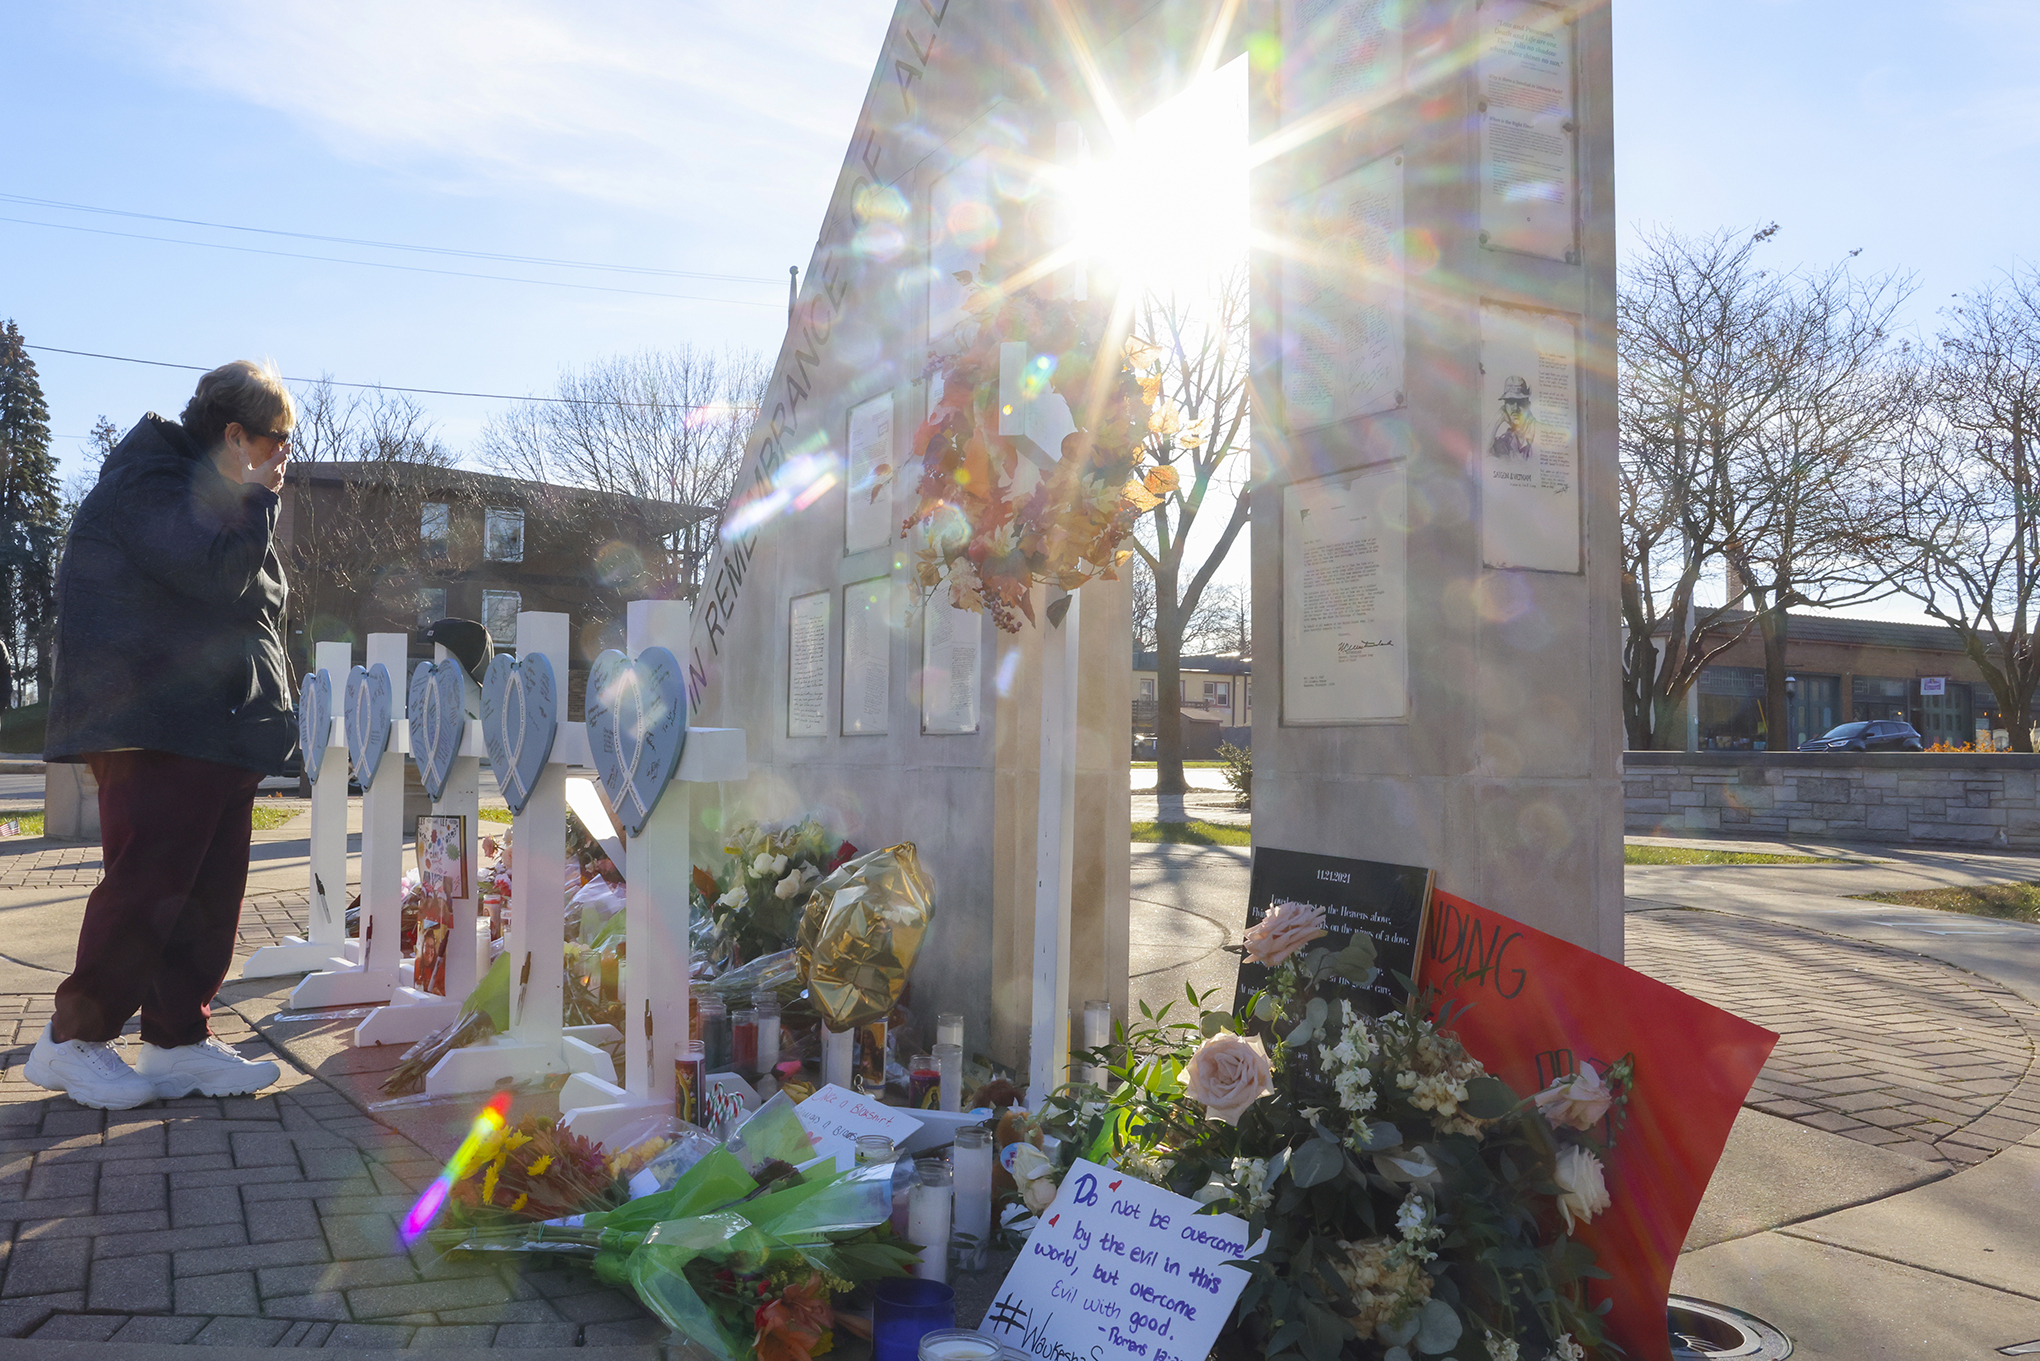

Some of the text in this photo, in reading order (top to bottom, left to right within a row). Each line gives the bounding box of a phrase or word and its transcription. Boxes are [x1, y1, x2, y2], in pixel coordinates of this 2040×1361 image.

[1535, 44, 1557, 57] shadow
[688, 650, 708, 714] IN
[704, 251, 847, 656] REMEMBRANCE
[850, 129, 882, 229] OF
[1328, 906, 1338, 916] the
[1340, 906, 1369, 920] Heavens
[1341, 924, 1352, 934] the
[1375, 930, 1385, 940] of
[1384, 934, 1390, 942] a
[812, 1086, 838, 1104] Once
[1073, 1174, 1098, 1207] Do
[1150, 1208, 1171, 1230] be
[1181, 1225, 1245, 1259] overcome
[1034, 1242, 1196, 1322] world, but overcome
[1072, 1220, 1222, 1294] by the evil in this
[1051, 1280, 1174, 1340] Evil with good.
